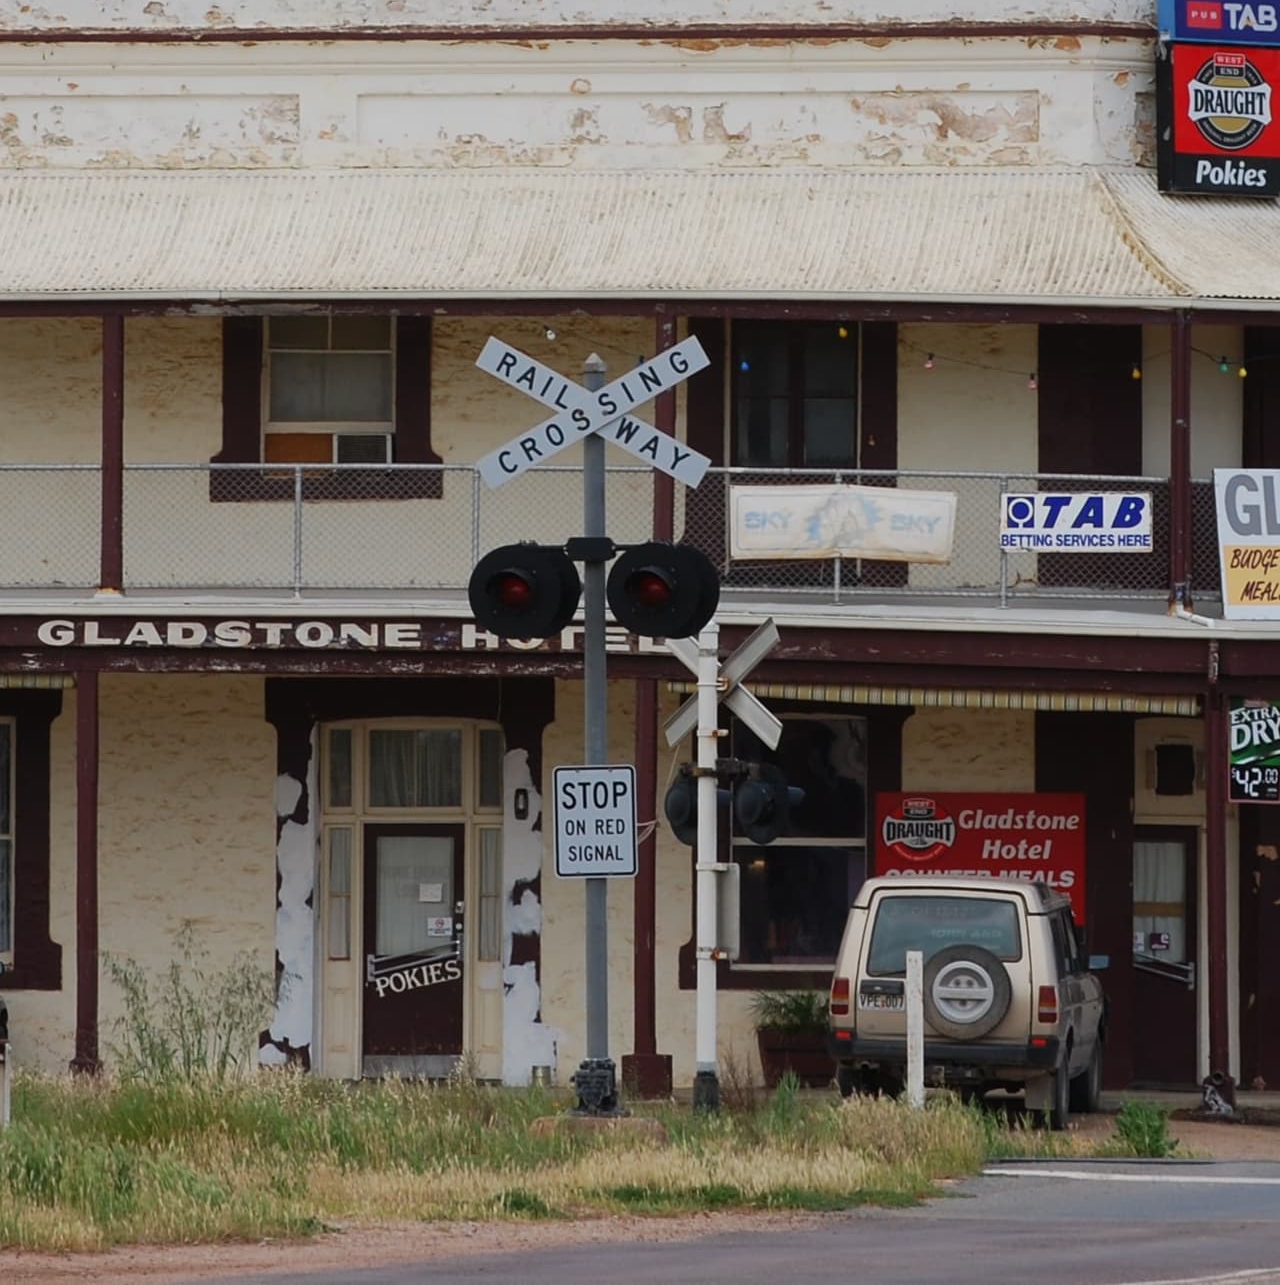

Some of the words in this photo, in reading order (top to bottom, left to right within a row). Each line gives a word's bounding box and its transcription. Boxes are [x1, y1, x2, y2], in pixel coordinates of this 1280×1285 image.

[1191, 11, 1218, 20] PUB
[1223, 2, 1278, 32] TAB
[1217, 56, 1242, 64] WEST
[1220, 67, 1240, 75] END
[1194, 89, 1266, 115] DRAUGHT
[1196, 160, 1267, 187] Pokies
[498, 351, 689, 474] CROSSING
[744, 511, 793, 529] SKY
[1043, 496, 1145, 528] TAB
[890, 513, 942, 533] SKY
[1001, 534, 1053, 547] BETTING
[1056, 534, 1115, 547] SERVICES
[1118, 534, 1151, 546] HERE
[36, 620, 421, 649] GLADSTONE
[1230, 706, 1280, 724] EXTRA
[562, 781, 628, 809] STOP
[565, 819, 586, 835] ON
[595, 819, 625, 835] RED
[958, 809, 1080, 830] Gladstone
[887, 821, 953, 842] DRAUGHT
[568, 845, 624, 861] SIGNAL
[982, 840, 1052, 860] Hotel
[376, 960, 461, 997] POKIES
